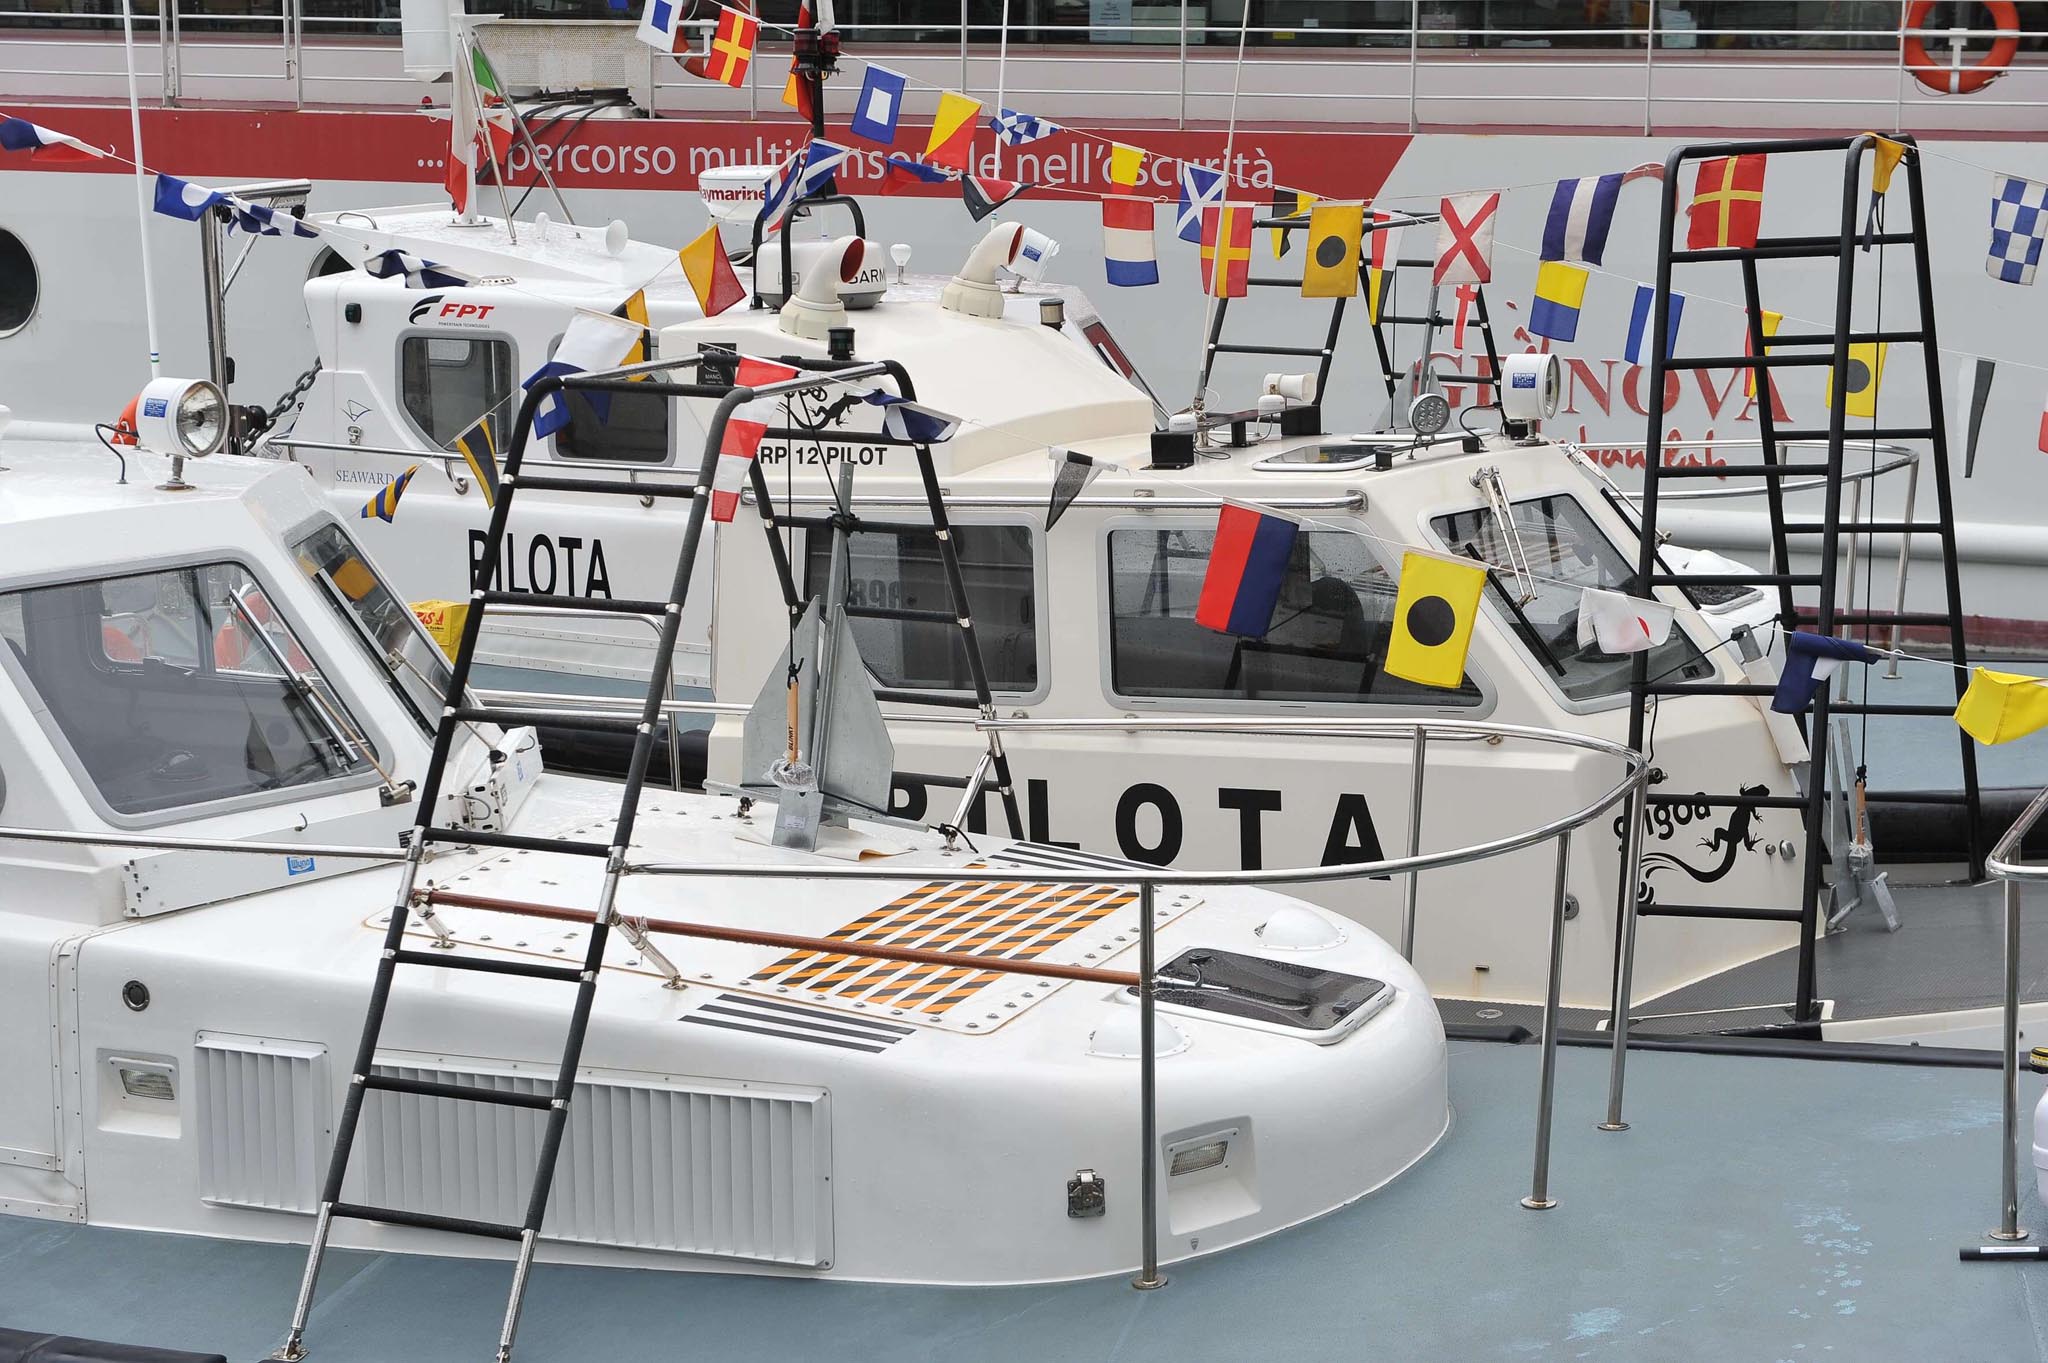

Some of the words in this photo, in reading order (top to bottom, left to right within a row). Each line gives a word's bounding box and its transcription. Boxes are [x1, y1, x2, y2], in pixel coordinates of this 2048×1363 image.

[507, 142, 677, 181] percorso
[701, 186, 766, 203] aymarine
[440, 303, 495, 320] FPT
[756, 446, 788, 464] RP
[796, 447, 819, 465] 12
[826, 447, 888, 466] PILOT
[336, 470, 395, 485] SEAWARD
[468, 529, 612, 600] PILOTA
